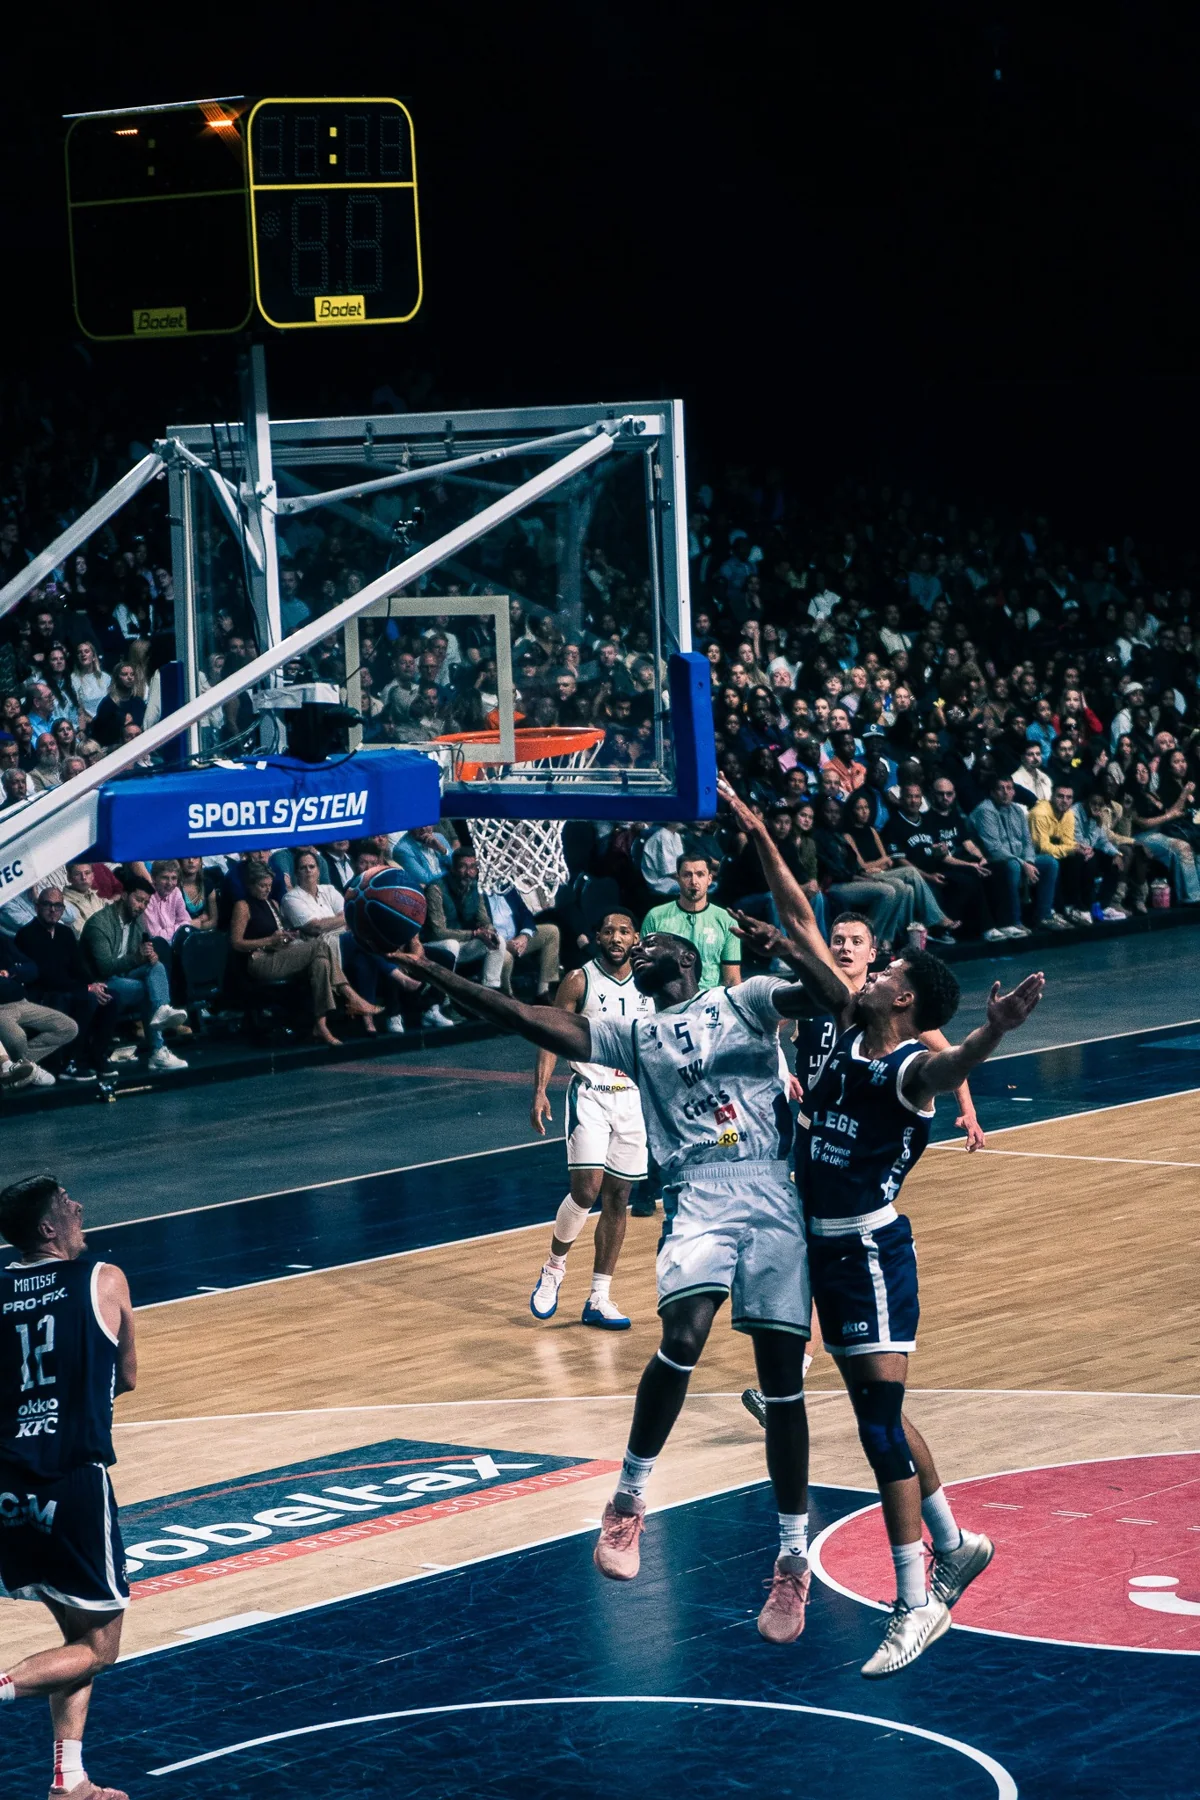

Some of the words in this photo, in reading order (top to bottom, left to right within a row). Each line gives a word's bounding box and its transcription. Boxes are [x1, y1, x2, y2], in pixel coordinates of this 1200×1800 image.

[318, 300, 362, 318] Bodet
[137, 312, 184, 331] Bodet
[618, 997, 625, 1016] 1
[674, 1021, 694, 1055] 5
[683, 1090, 730, 1120] Circs
[824, 1142, 851, 1156] Province
[14, 1272, 57, 1292] MATISSE
[15, 1314, 56, 1392] 12
[15, 1417, 58, 1438] KFC
[199, 1549, 290, 1575] BEST
[296, 1514, 431, 1549] RENTAL
[432, 1469, 592, 1513] SOLUTION
